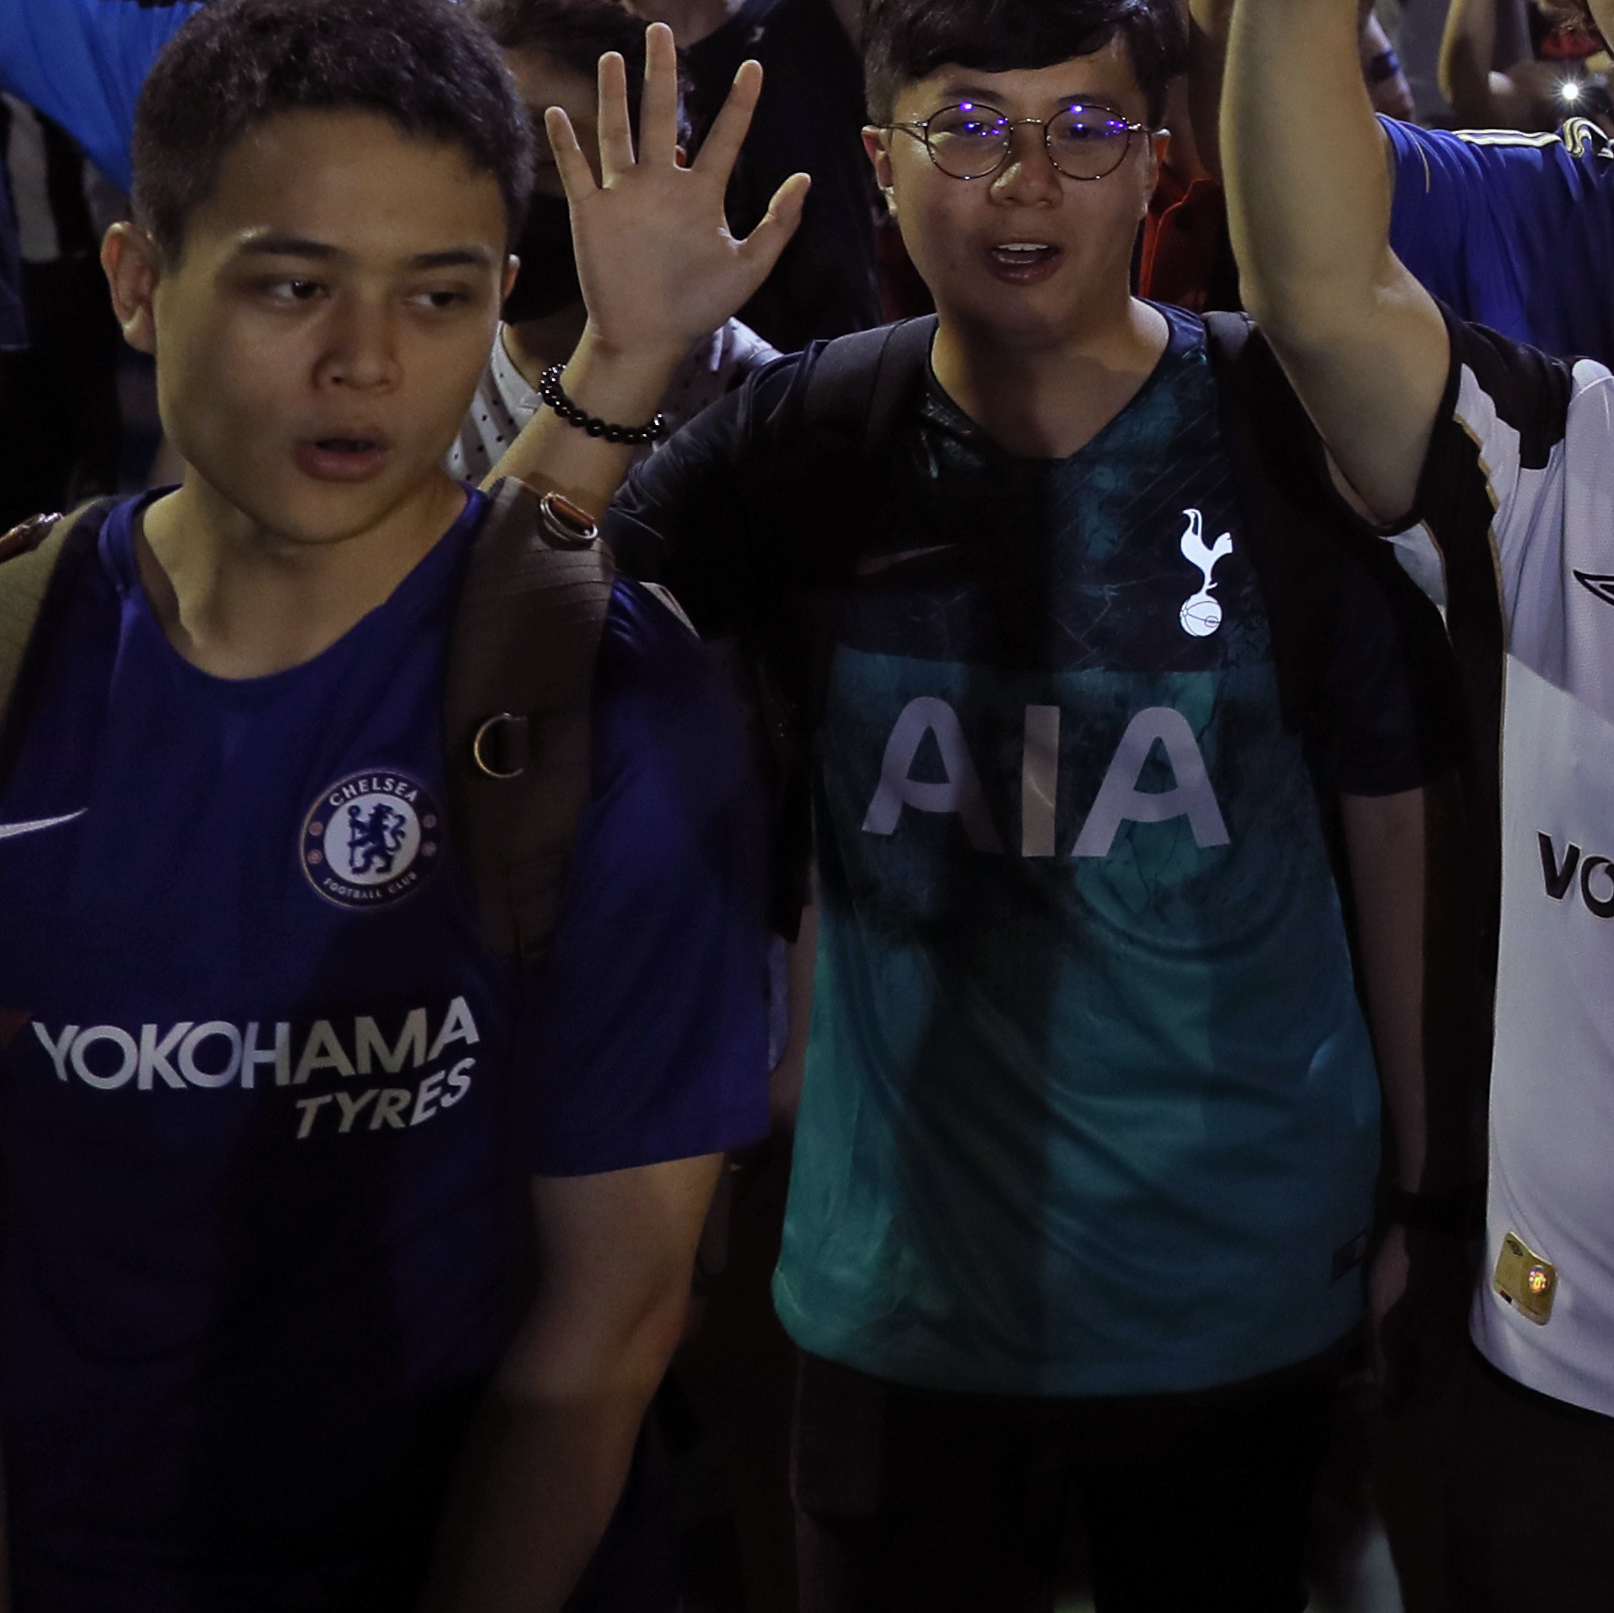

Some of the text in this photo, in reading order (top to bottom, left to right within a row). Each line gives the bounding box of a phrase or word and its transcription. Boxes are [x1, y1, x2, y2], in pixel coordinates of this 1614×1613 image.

[328, 776, 419, 806] CHELSEA
[860, 695, 1232, 858] AIA
[323, 870, 418, 899] FOOTBALL CLUB
[31, 994, 481, 1091] YOKOHAMA
[295, 1056, 476, 1140] TYRES
